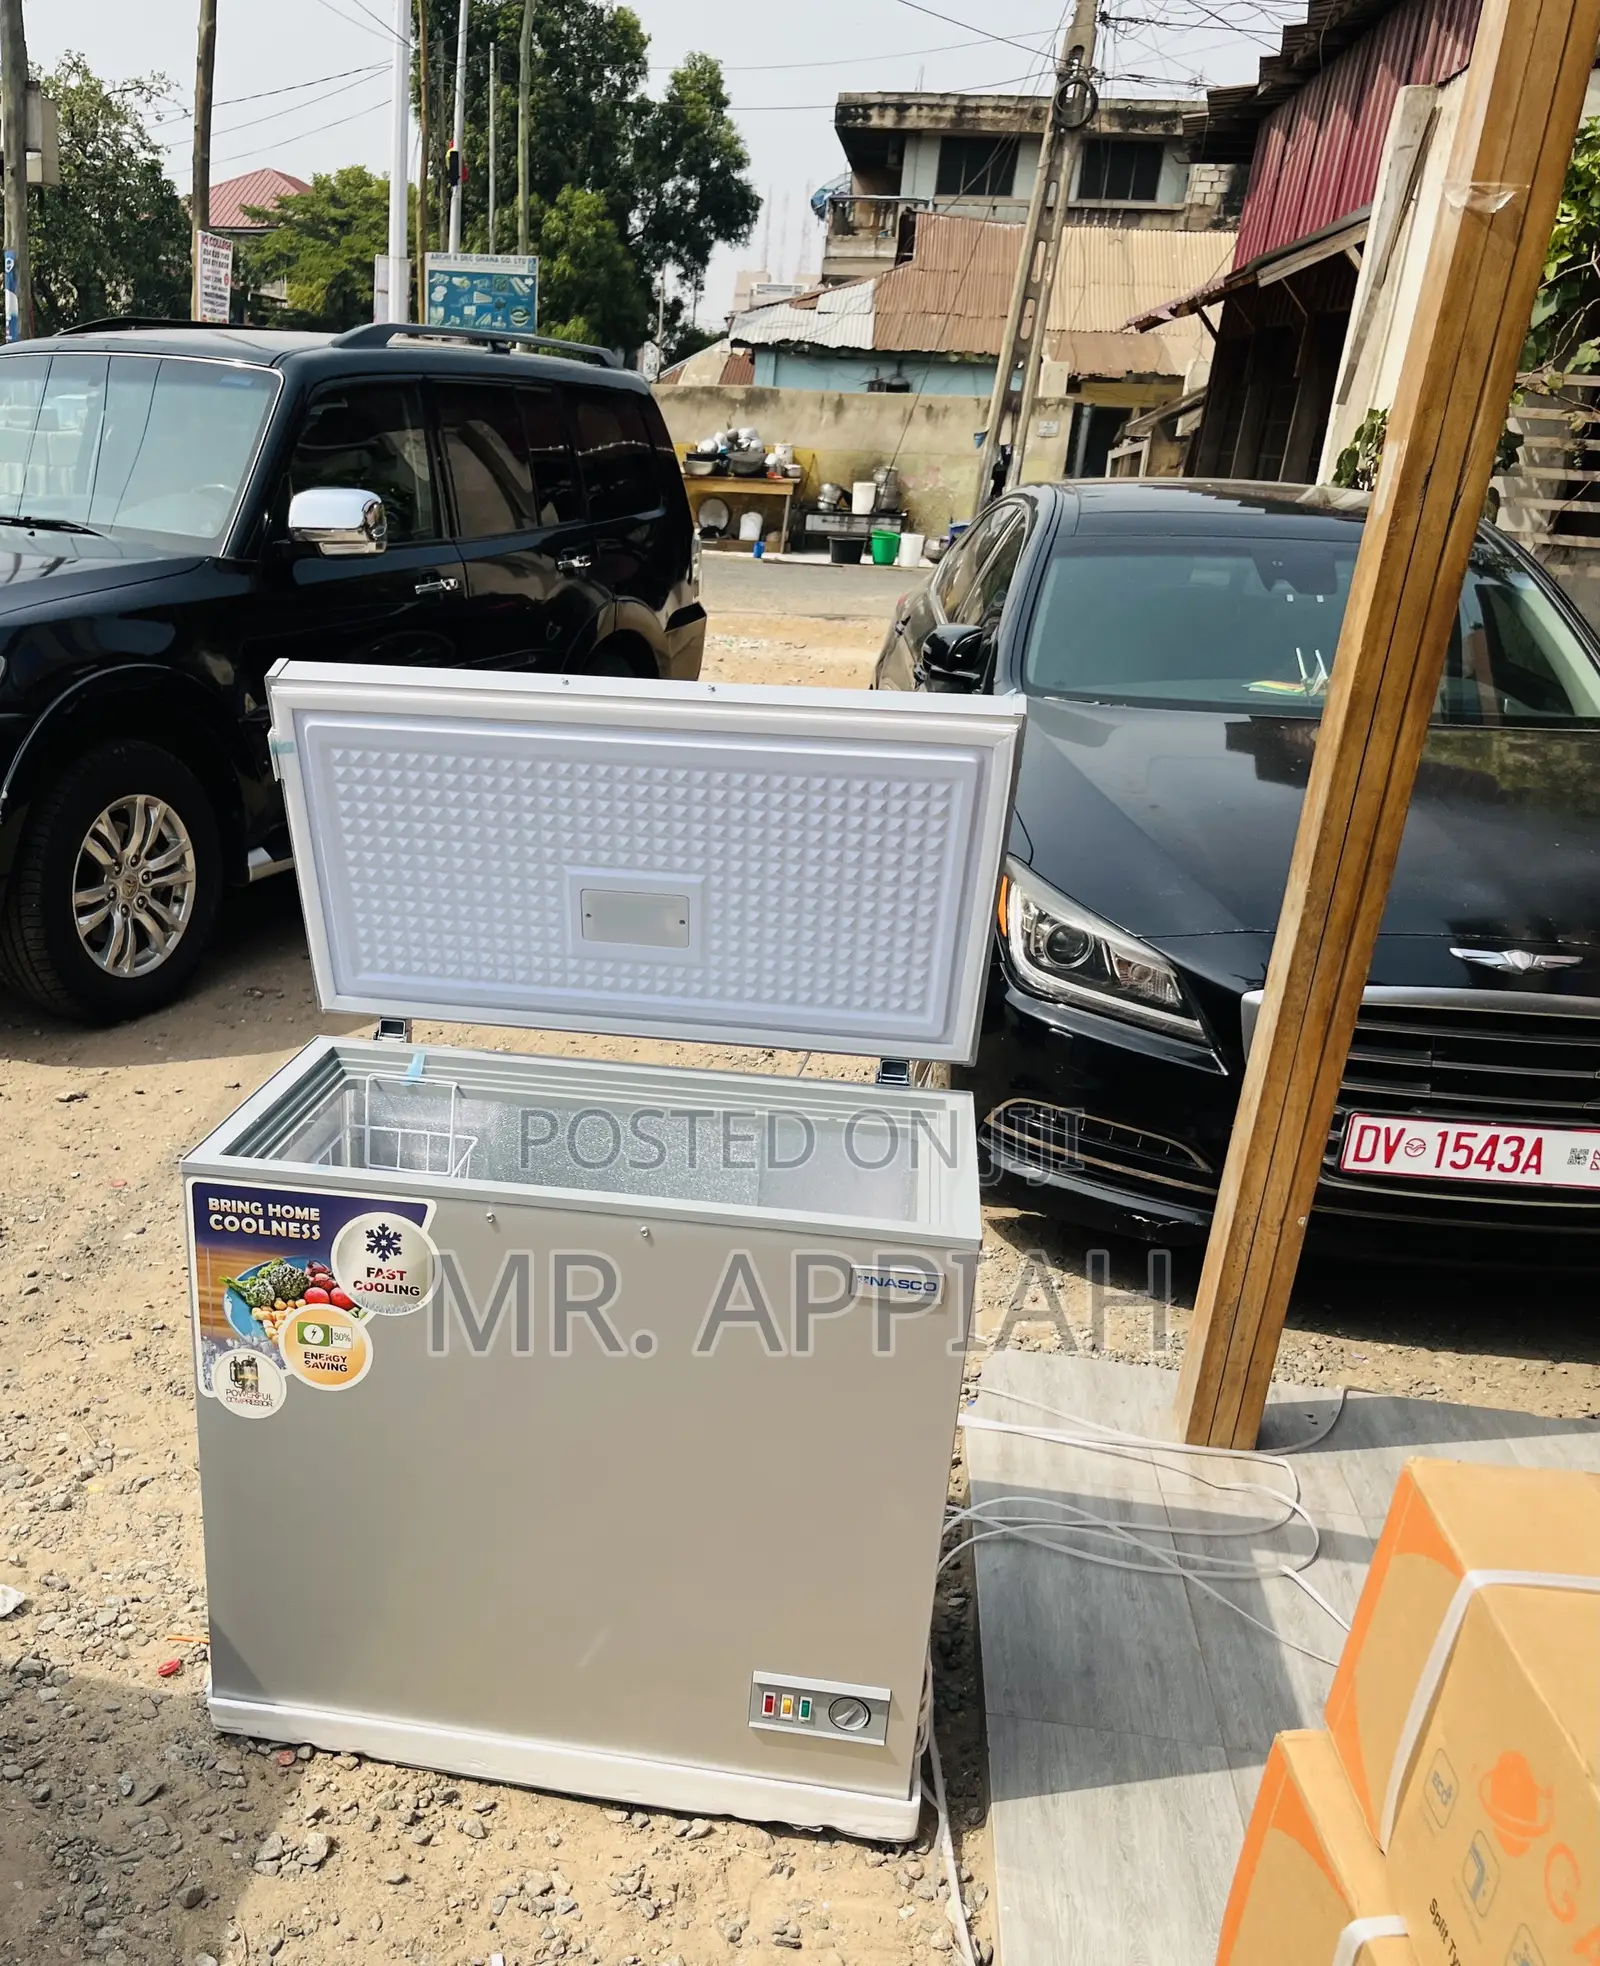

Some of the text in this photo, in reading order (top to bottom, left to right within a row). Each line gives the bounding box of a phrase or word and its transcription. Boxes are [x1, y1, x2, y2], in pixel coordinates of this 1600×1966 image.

[209, 236, 232, 251] COLLEGE
[475, 255, 499, 263] GHANA
[1352, 1124, 1543, 1175] DV 1543A
[208, 1197, 320, 1222] BRING HOME
[209, 1213, 321, 1241] COOLNESS
[366, 1266, 407, 1281] FAST
[353, 1280, 420, 1296] COOLING
[870, 1276, 937, 1292] NASCO
[334, 1332, 352, 1342] 30%
[303, 1351, 347, 1364] ENERGY
[304, 1360, 348, 1373] SAVING
[225, 1388, 274, 1401] POWERFUL
[1429, 1897, 1449, 1945] Split
